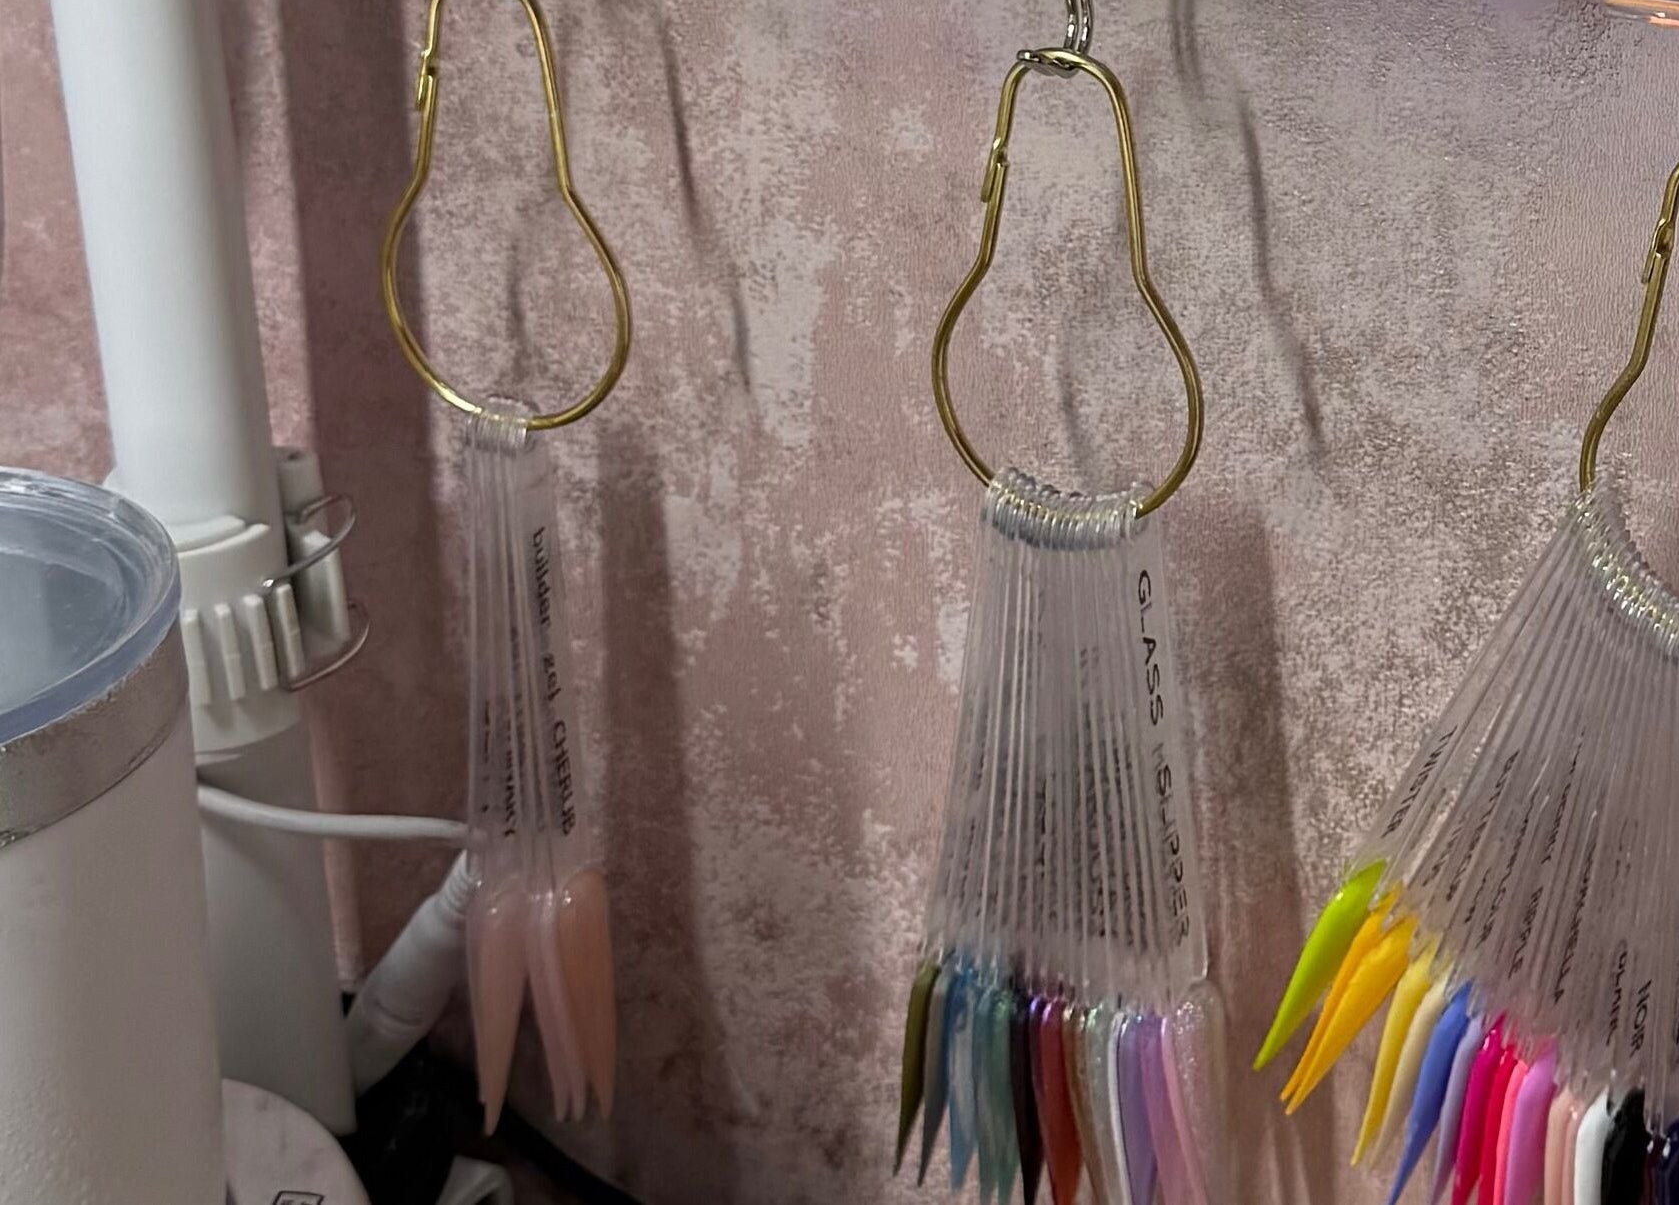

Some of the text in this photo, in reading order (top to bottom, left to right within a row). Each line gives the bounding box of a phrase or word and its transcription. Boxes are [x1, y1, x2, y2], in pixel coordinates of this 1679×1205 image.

[551, 720, 577, 837] CHERUB
[1137, 569, 1191, 947] GLASS SLIPPER
[1630, 980, 1653, 1058] NOIR
